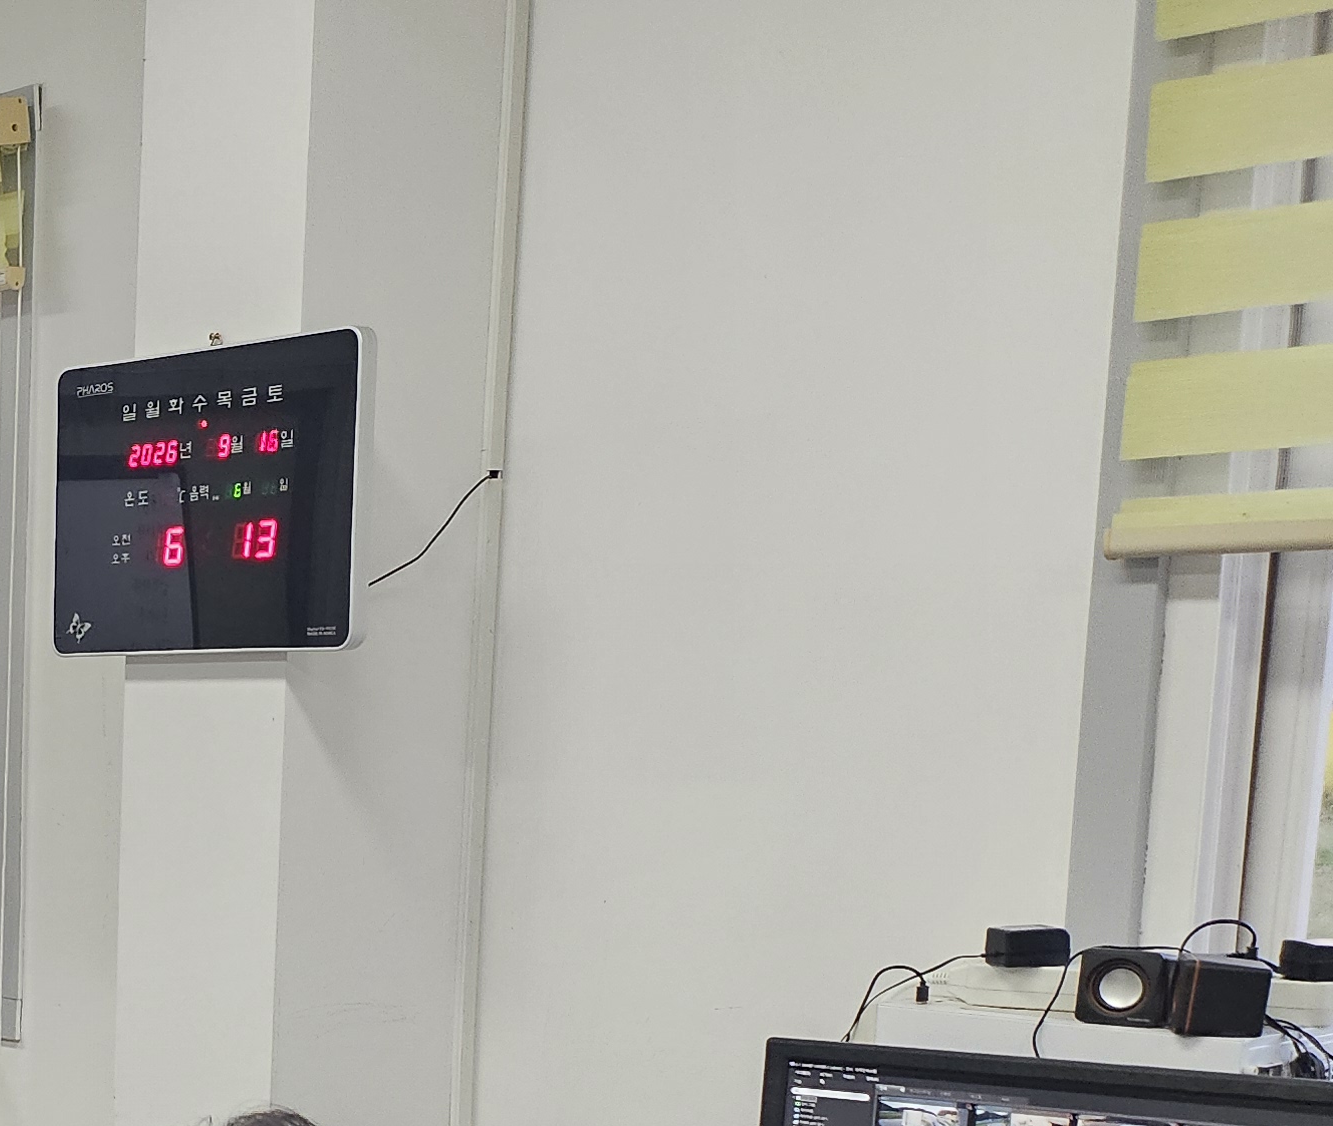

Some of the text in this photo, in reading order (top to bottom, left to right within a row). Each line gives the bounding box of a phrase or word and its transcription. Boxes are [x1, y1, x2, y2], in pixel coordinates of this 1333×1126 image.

[77, 382, 114, 398] PHAROS
[122, 384, 283, 422] 일 월 화 수 목 금 토
[124, 489, 149, 507] 온도
[189, 485, 209, 502] 음력
[163, 518, 278, 567] 6 13
